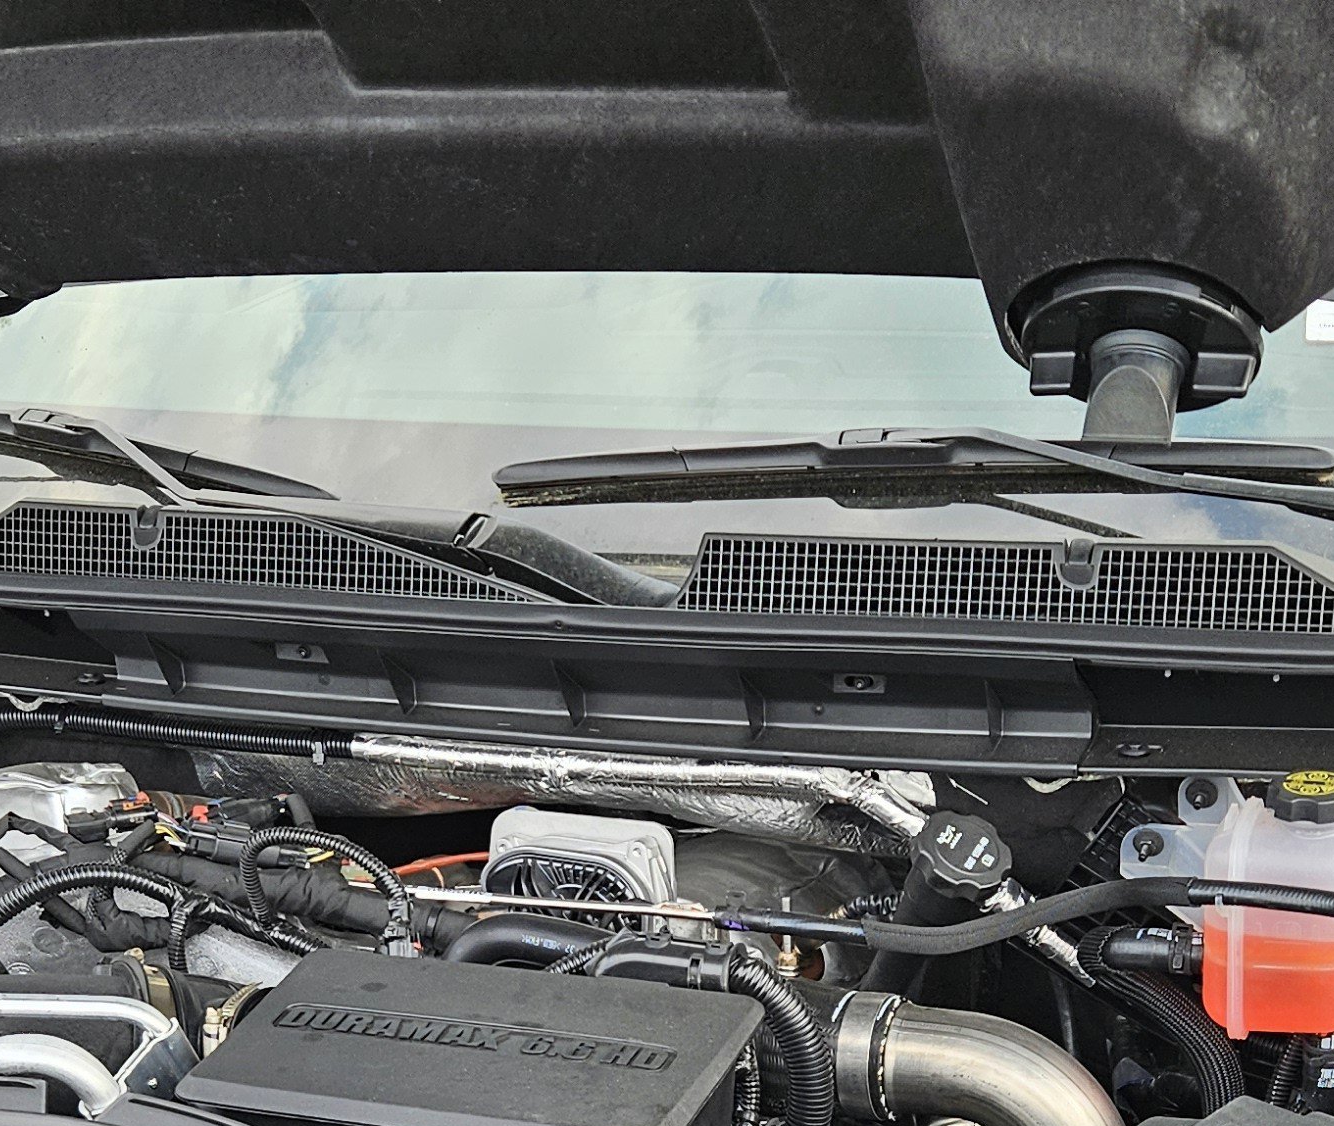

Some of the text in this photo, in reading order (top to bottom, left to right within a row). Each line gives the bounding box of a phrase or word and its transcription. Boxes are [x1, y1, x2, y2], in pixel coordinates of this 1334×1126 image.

[278, 1007, 669, 1073] DURAMAX 6.6 HD
